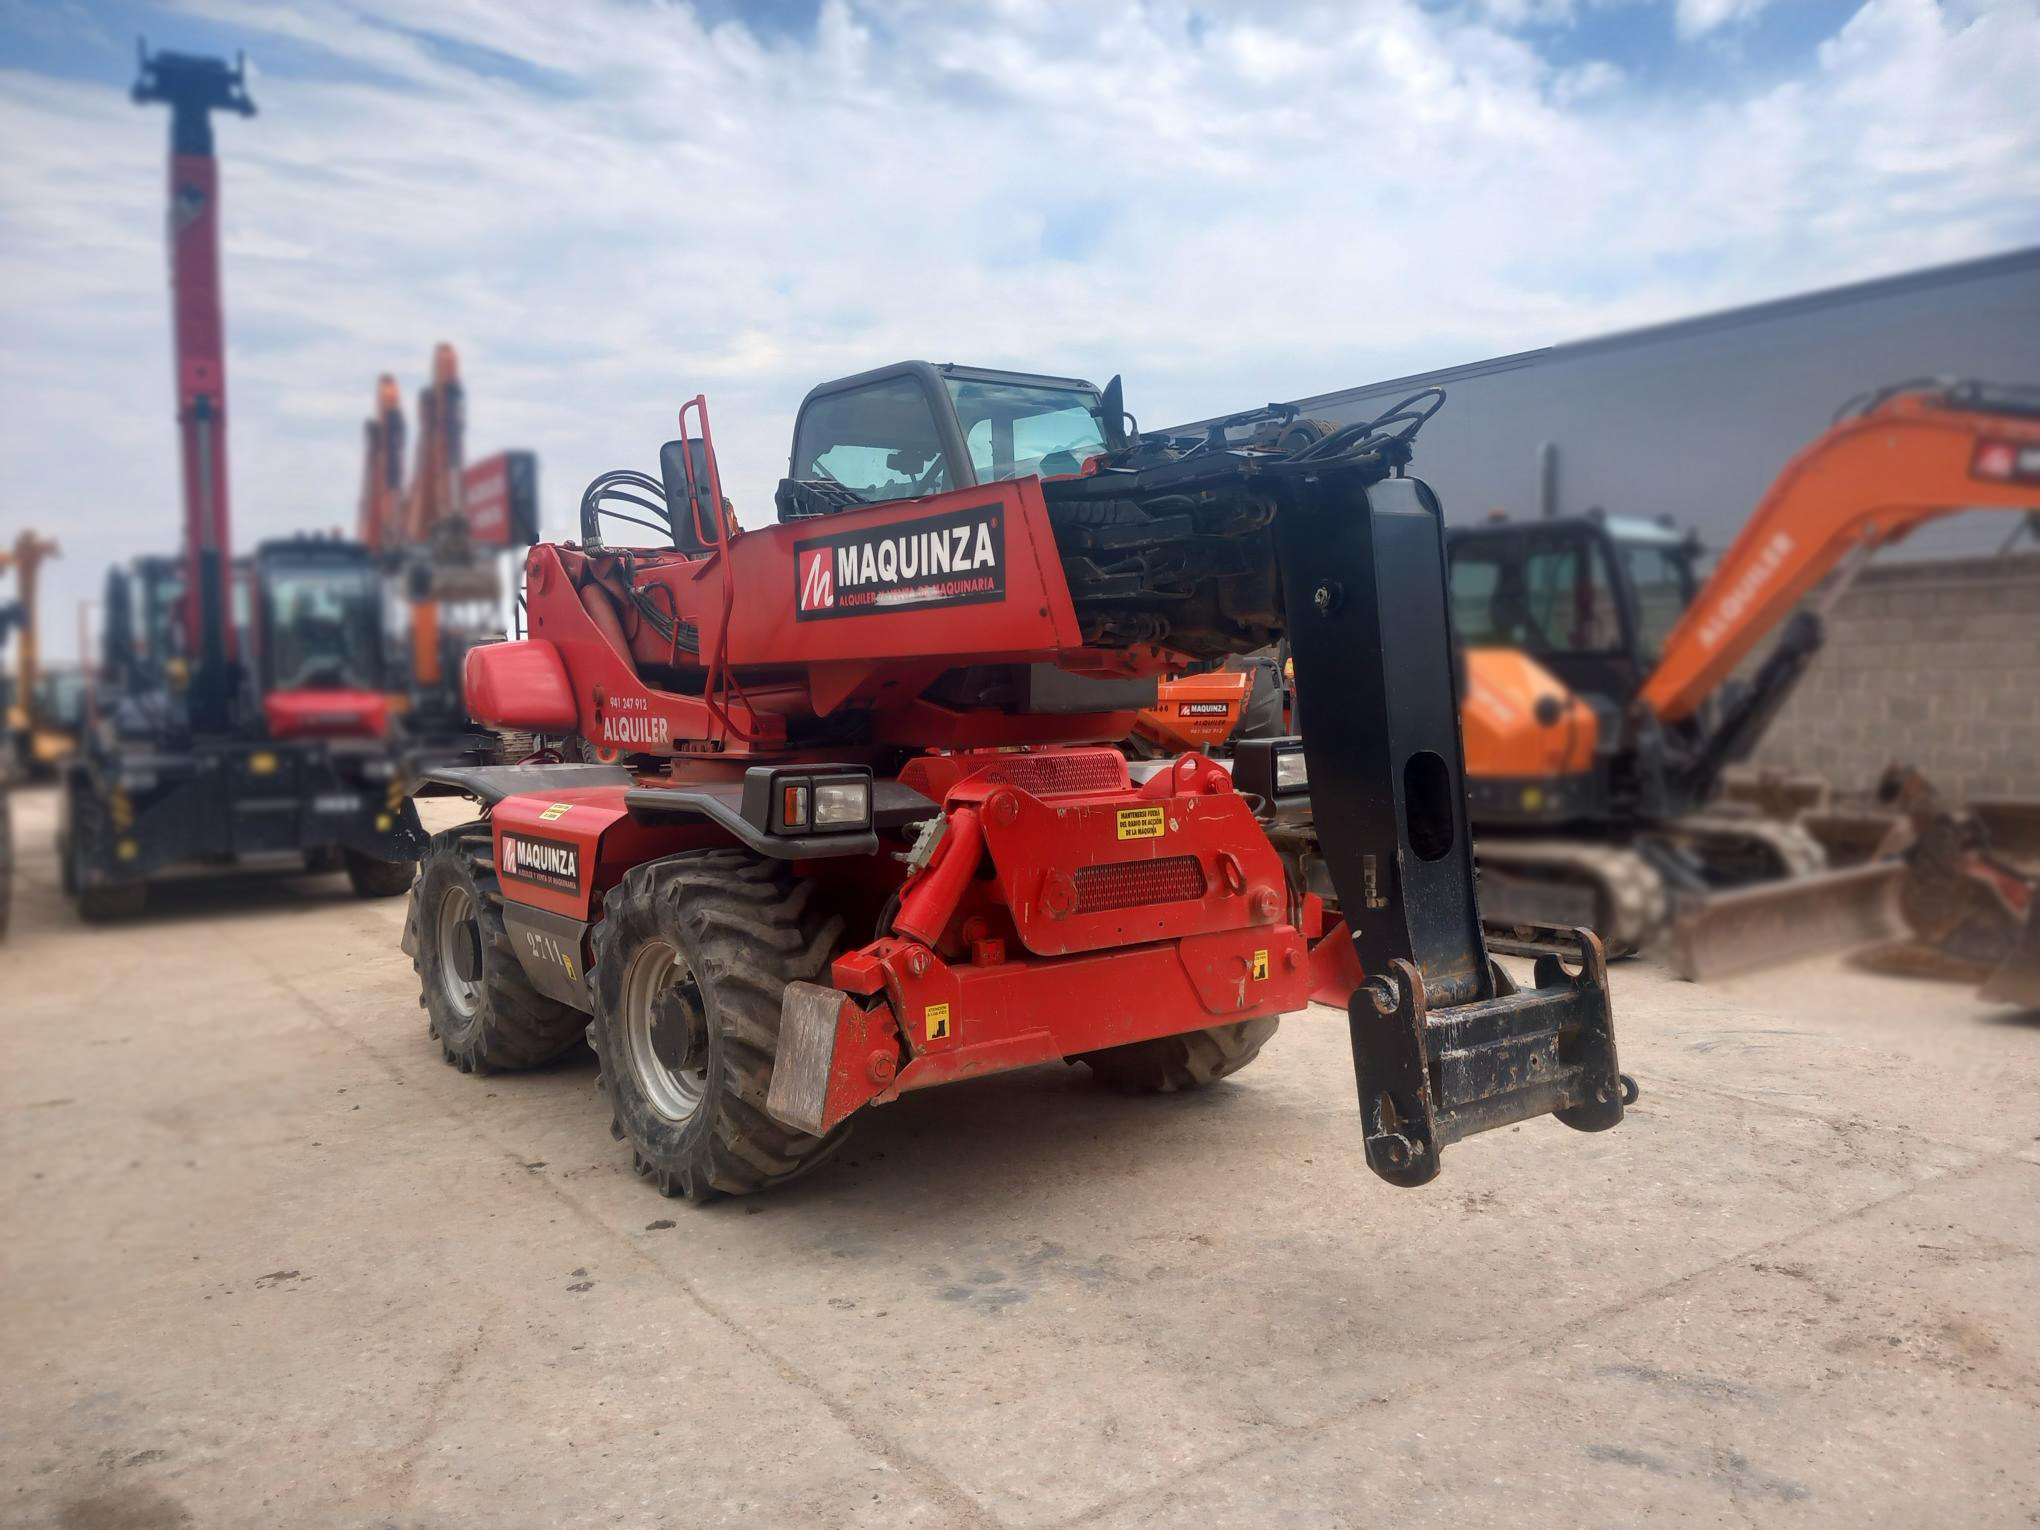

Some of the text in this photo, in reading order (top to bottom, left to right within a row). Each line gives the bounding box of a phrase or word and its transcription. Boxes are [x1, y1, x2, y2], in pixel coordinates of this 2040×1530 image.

[838, 522, 995, 586] MAQUINZA
[839, 592, 877, 607] ALQUILER
[610, 697, 648, 710] 941 247 912
[1190, 704, 1227, 713] MAQUINZA
[603, 716, 669, 743] ALQUILER
[516, 840, 577, 878] MAQUINZA
[526, 931, 564, 966] 2711
